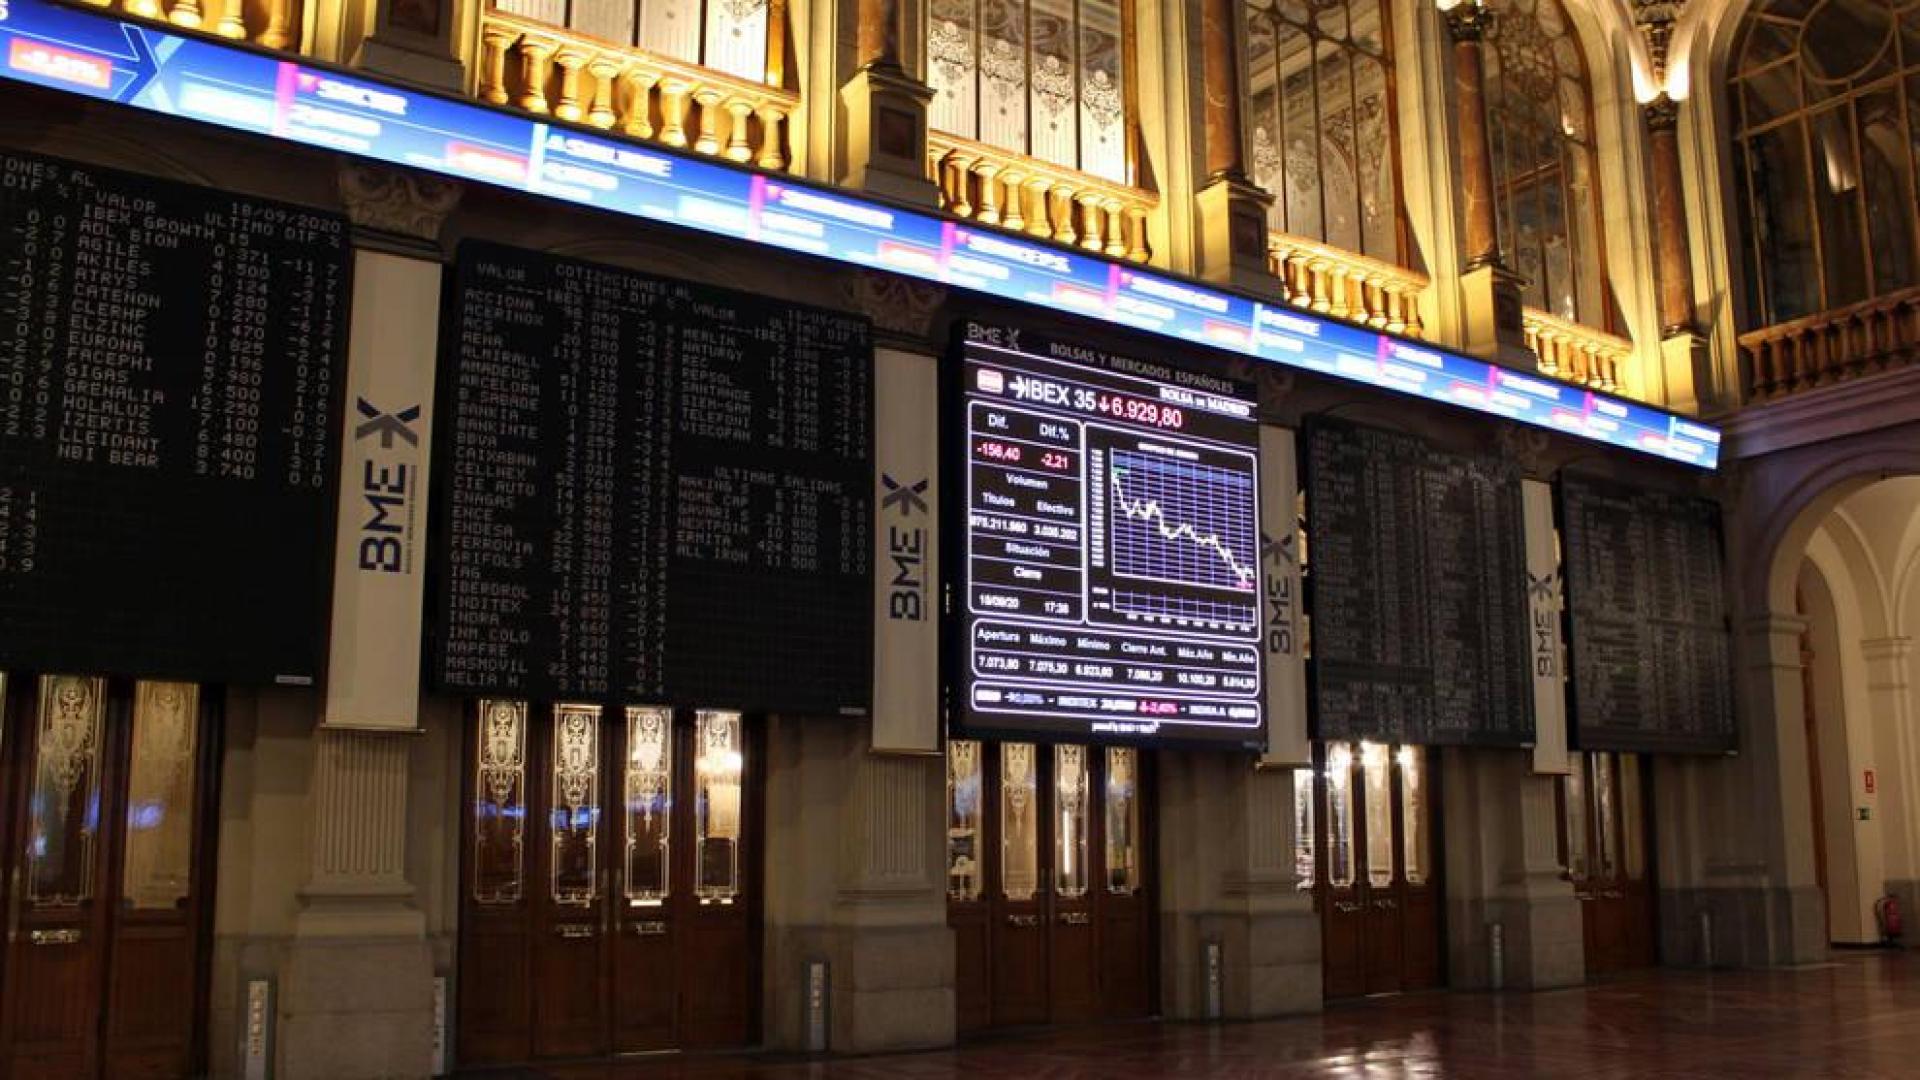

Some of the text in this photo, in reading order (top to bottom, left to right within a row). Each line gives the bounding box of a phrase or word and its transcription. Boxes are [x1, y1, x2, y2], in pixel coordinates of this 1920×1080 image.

[96, 190, 157, 214] VALOR
[77, 252, 152, 277] AKILES
[71, 314, 145, 339] ELZINC
[463, 303, 545, 326] ACERINOX
[966, 323, 1002, 344] BME
[67, 347, 154, 372] FACEPHI
[1050, 341, 1235, 394] BOLSAS Y MERCADOS ESPAÑOLES
[65, 362, 130, 384] GIGAS
[63, 395, 152, 420] HOLALUZ
[1073, 388, 1098, 412] 35
[1111, 396, 1184, 430] 6.929,80
[359, 459, 407, 574] BME
[889, 525, 922, 621] BME
[1267, 574, 1291, 655] BME
[977, 627, 1020, 643] Apertura
[1534, 608, 1554, 678] BME
